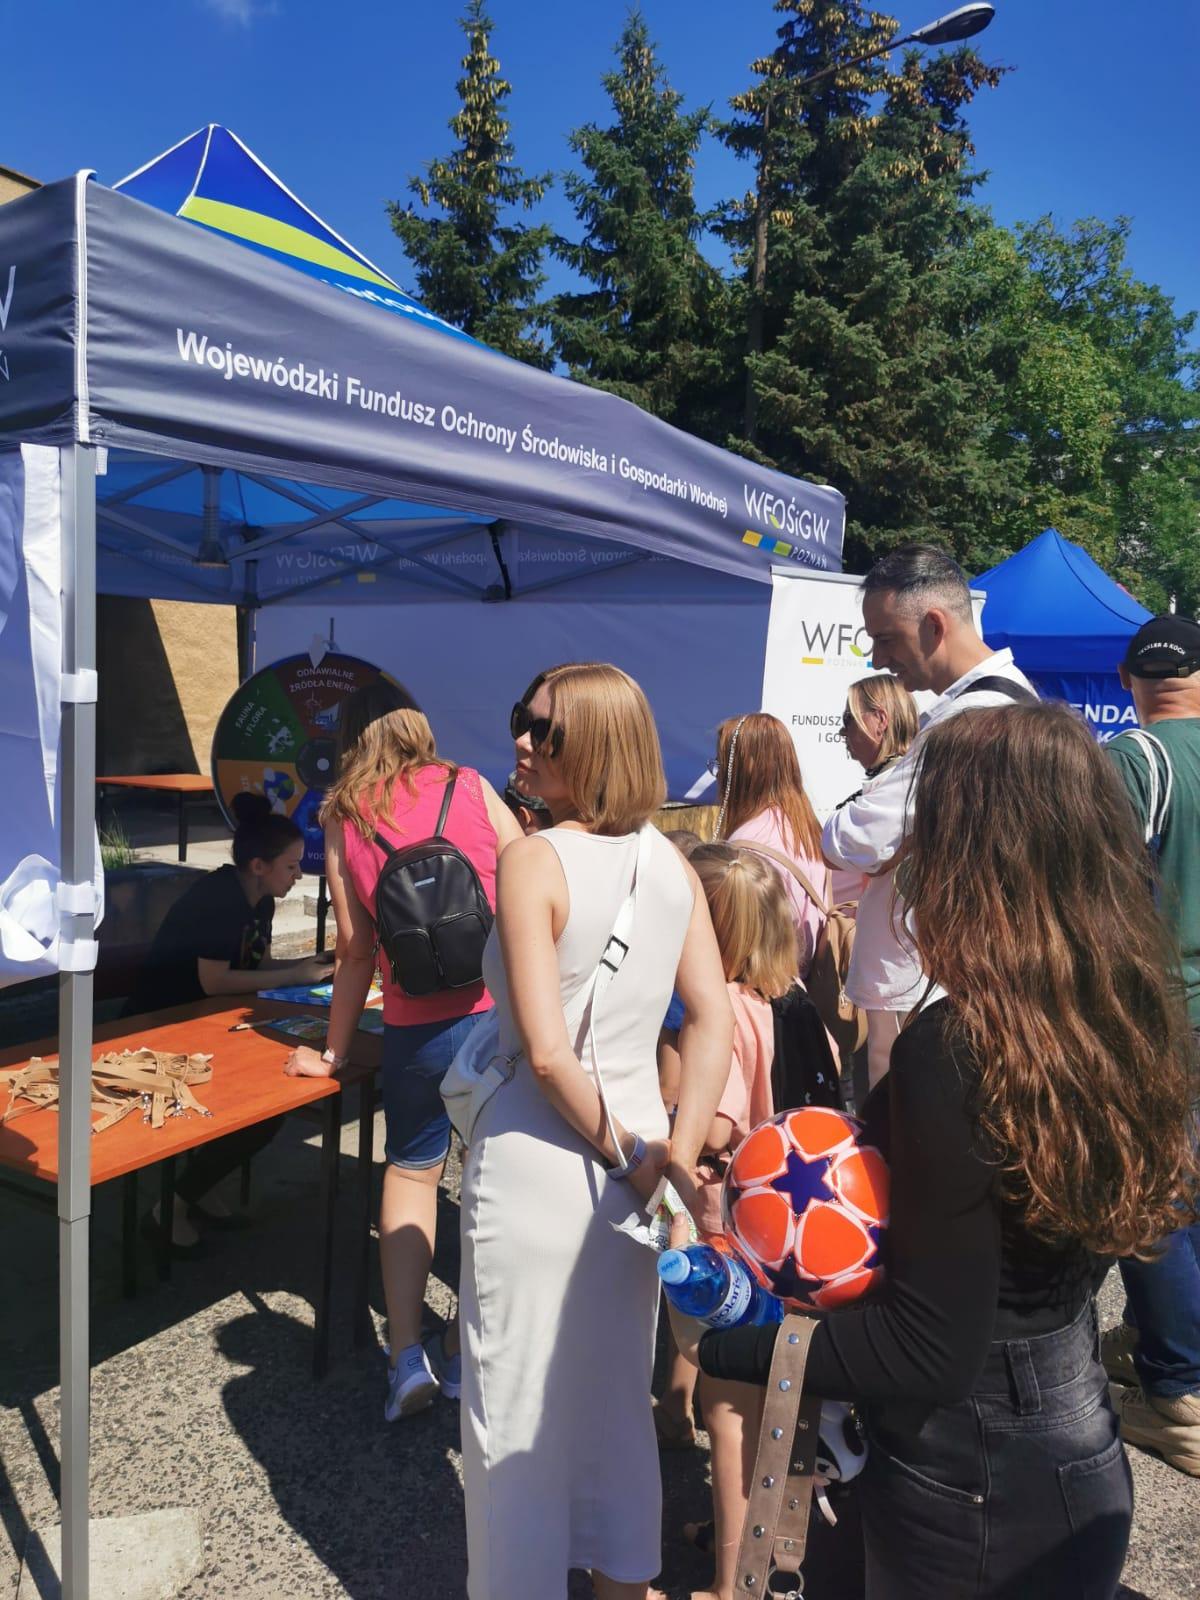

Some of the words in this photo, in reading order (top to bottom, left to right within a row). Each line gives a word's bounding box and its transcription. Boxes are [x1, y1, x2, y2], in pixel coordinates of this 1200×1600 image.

[176, 327, 339, 401] Wojewódzki
[345, 376, 437, 427] Fundusz
[440, 405, 518, 453] Ochrony
[521, 423, 609, 473] Środowiska
[611, 453, 617, 475] i
[619, 456, 688, 500] Gospodarki
[690, 483, 729, 519] Wodnej
[743, 483, 830, 545] WFOŚiGW
[801, 620, 874, 657] WFO
[297, 667, 354, 681] ODNAWIALNE
[327, 679, 358, 693] ENERG
[792, 714, 842, 726] FUNDUSZ
[1069, 703, 1139, 724] NDA
